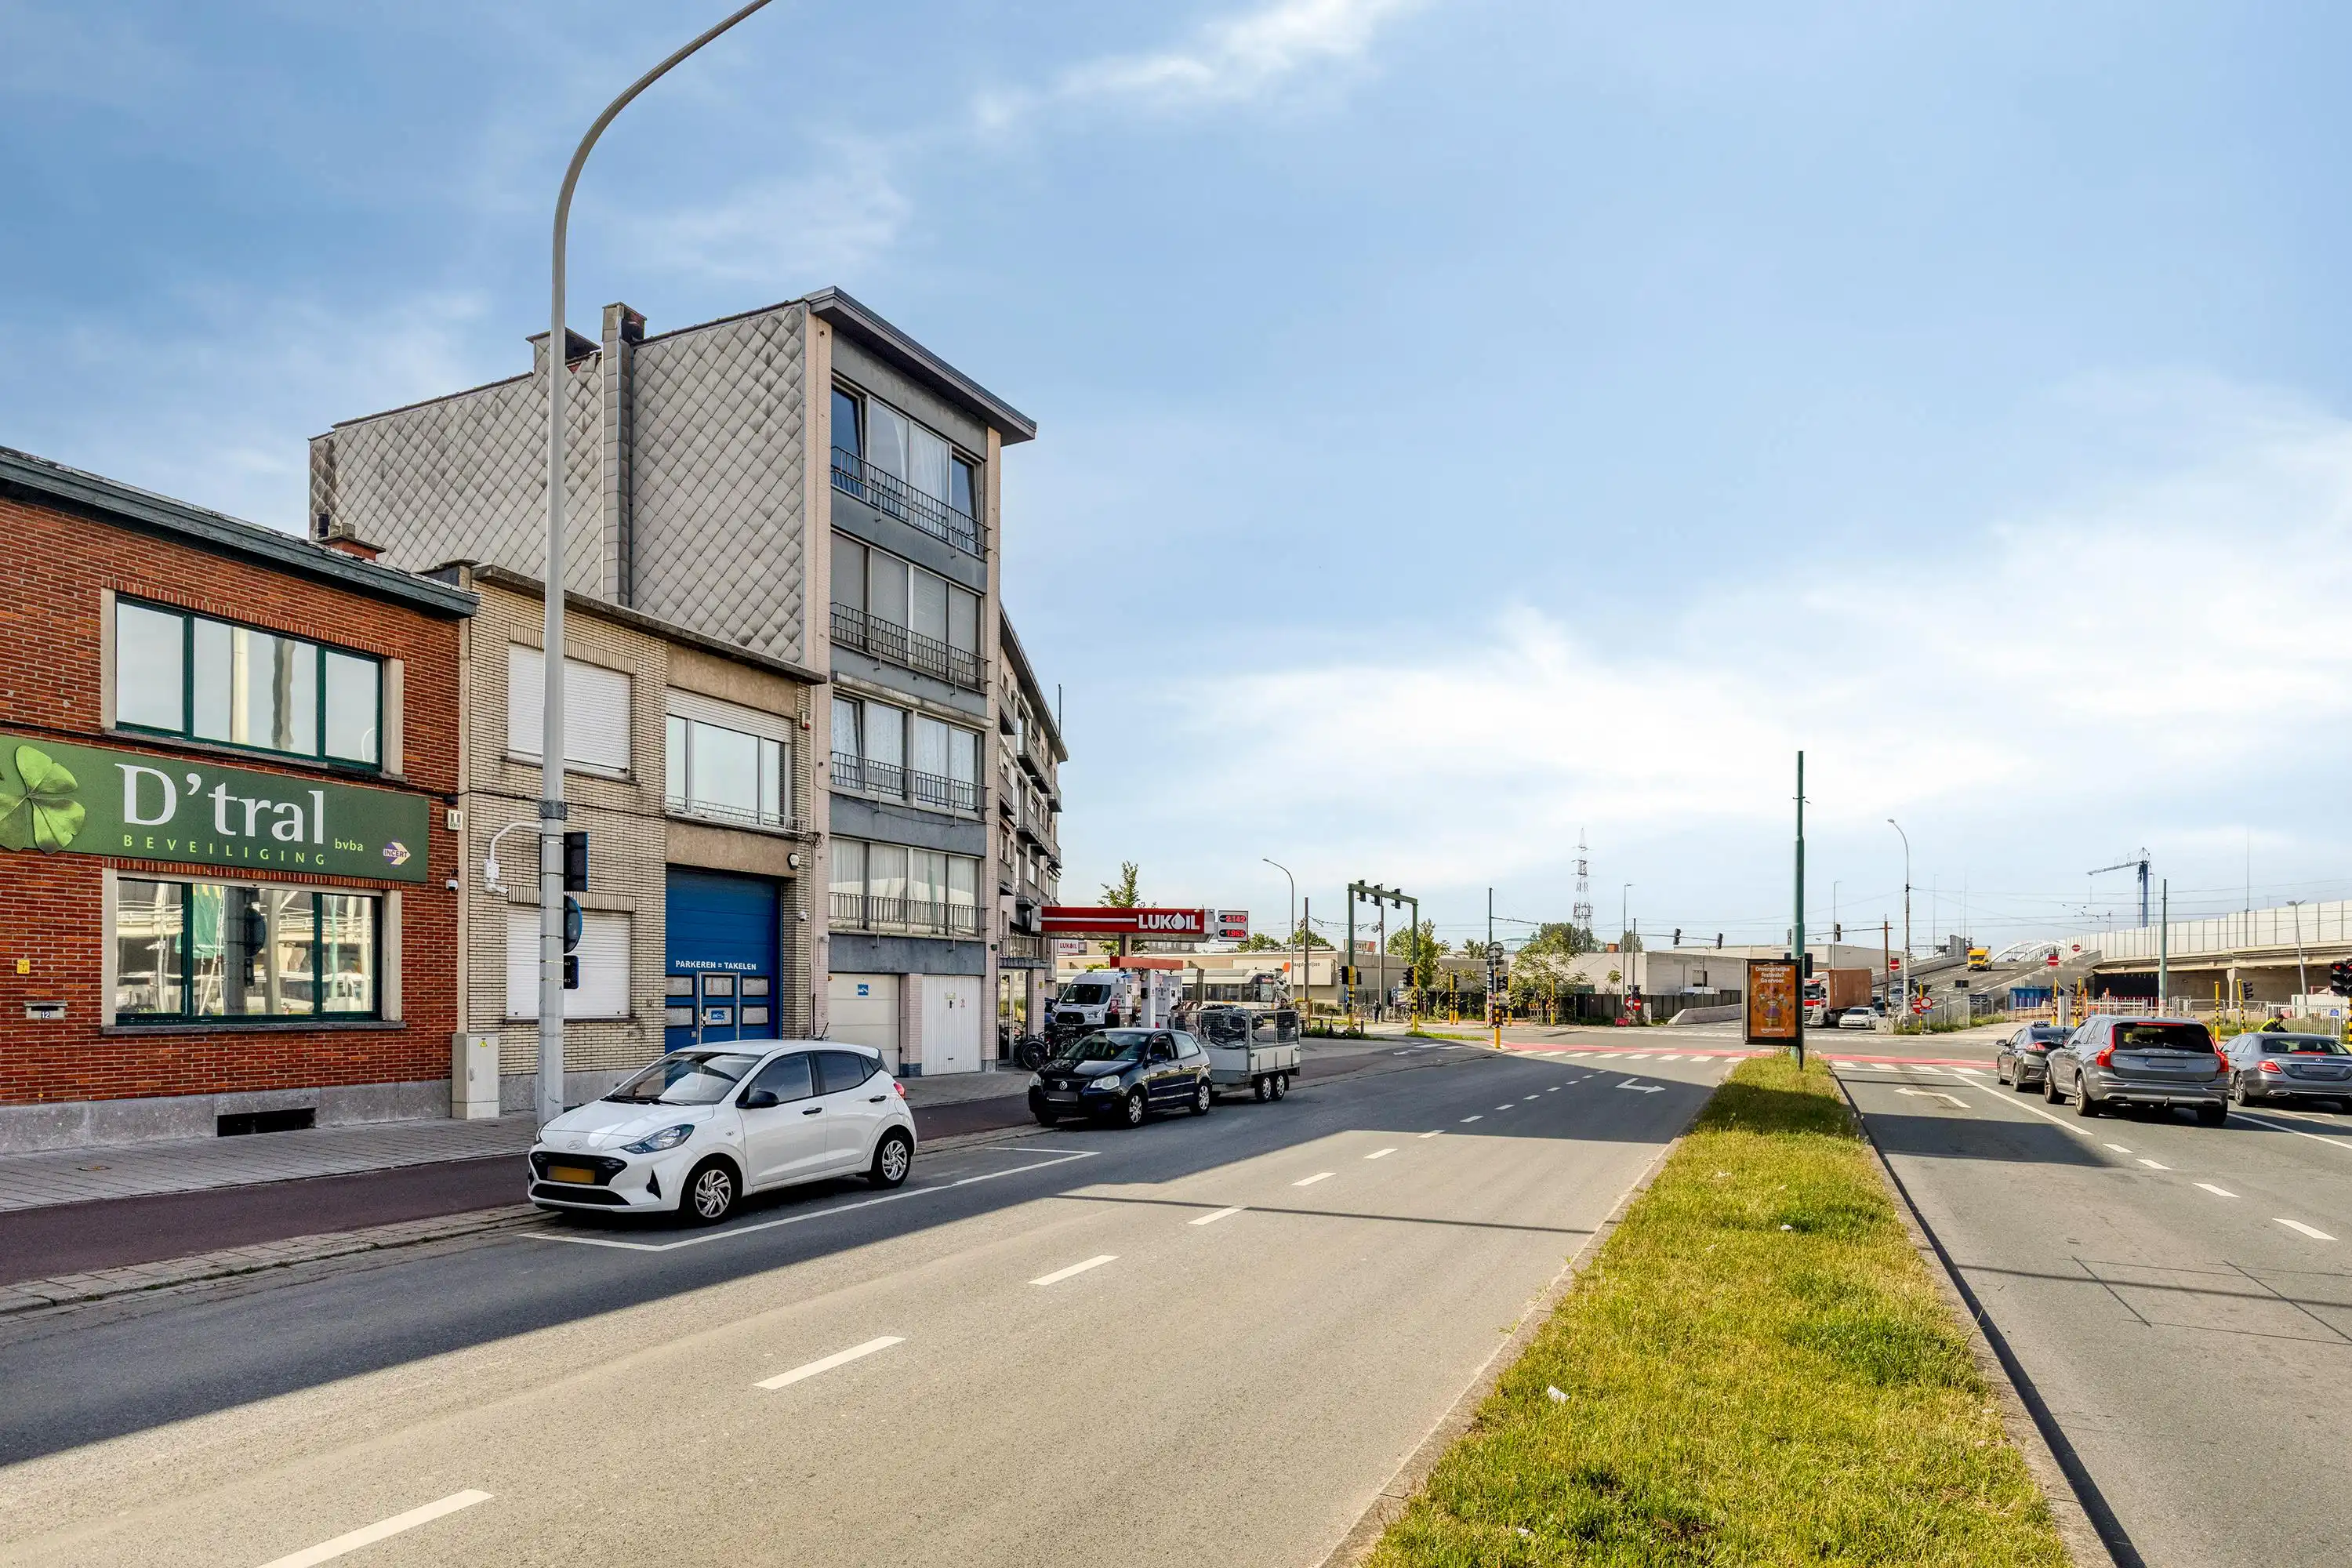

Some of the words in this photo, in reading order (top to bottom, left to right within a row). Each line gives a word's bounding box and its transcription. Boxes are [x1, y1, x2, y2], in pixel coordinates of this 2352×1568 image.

[114, 763, 324, 844] D'tral
[123, 834, 325, 865] BEVEILIGING
[335, 838, 363, 851] bvba
[384, 848, 408, 858] INCERT
[1138, 912, 1200, 930] LUKOIL
